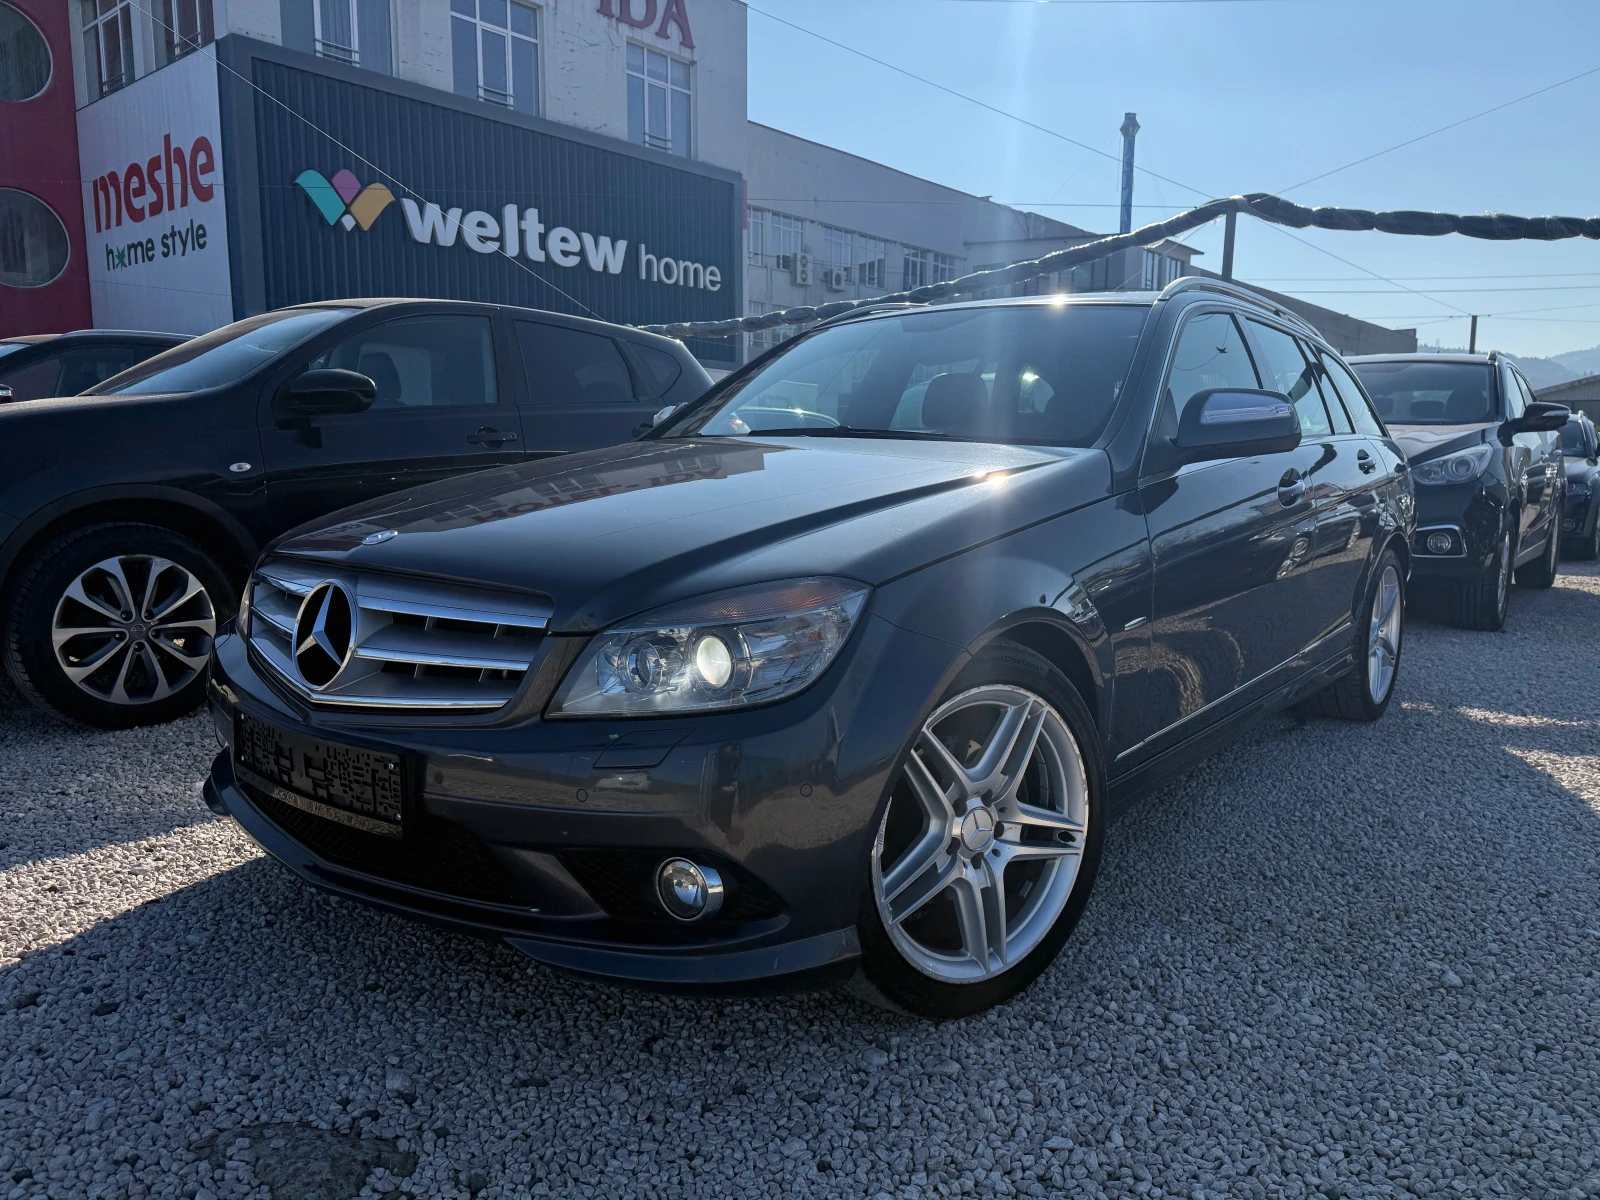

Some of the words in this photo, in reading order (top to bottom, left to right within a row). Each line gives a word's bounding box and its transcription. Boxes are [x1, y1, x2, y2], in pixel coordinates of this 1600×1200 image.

[92, 132, 215, 234] meshe
[161, 218, 207, 257] style
[401, 197, 628, 275] weltew
[638, 243, 722, 291] home
